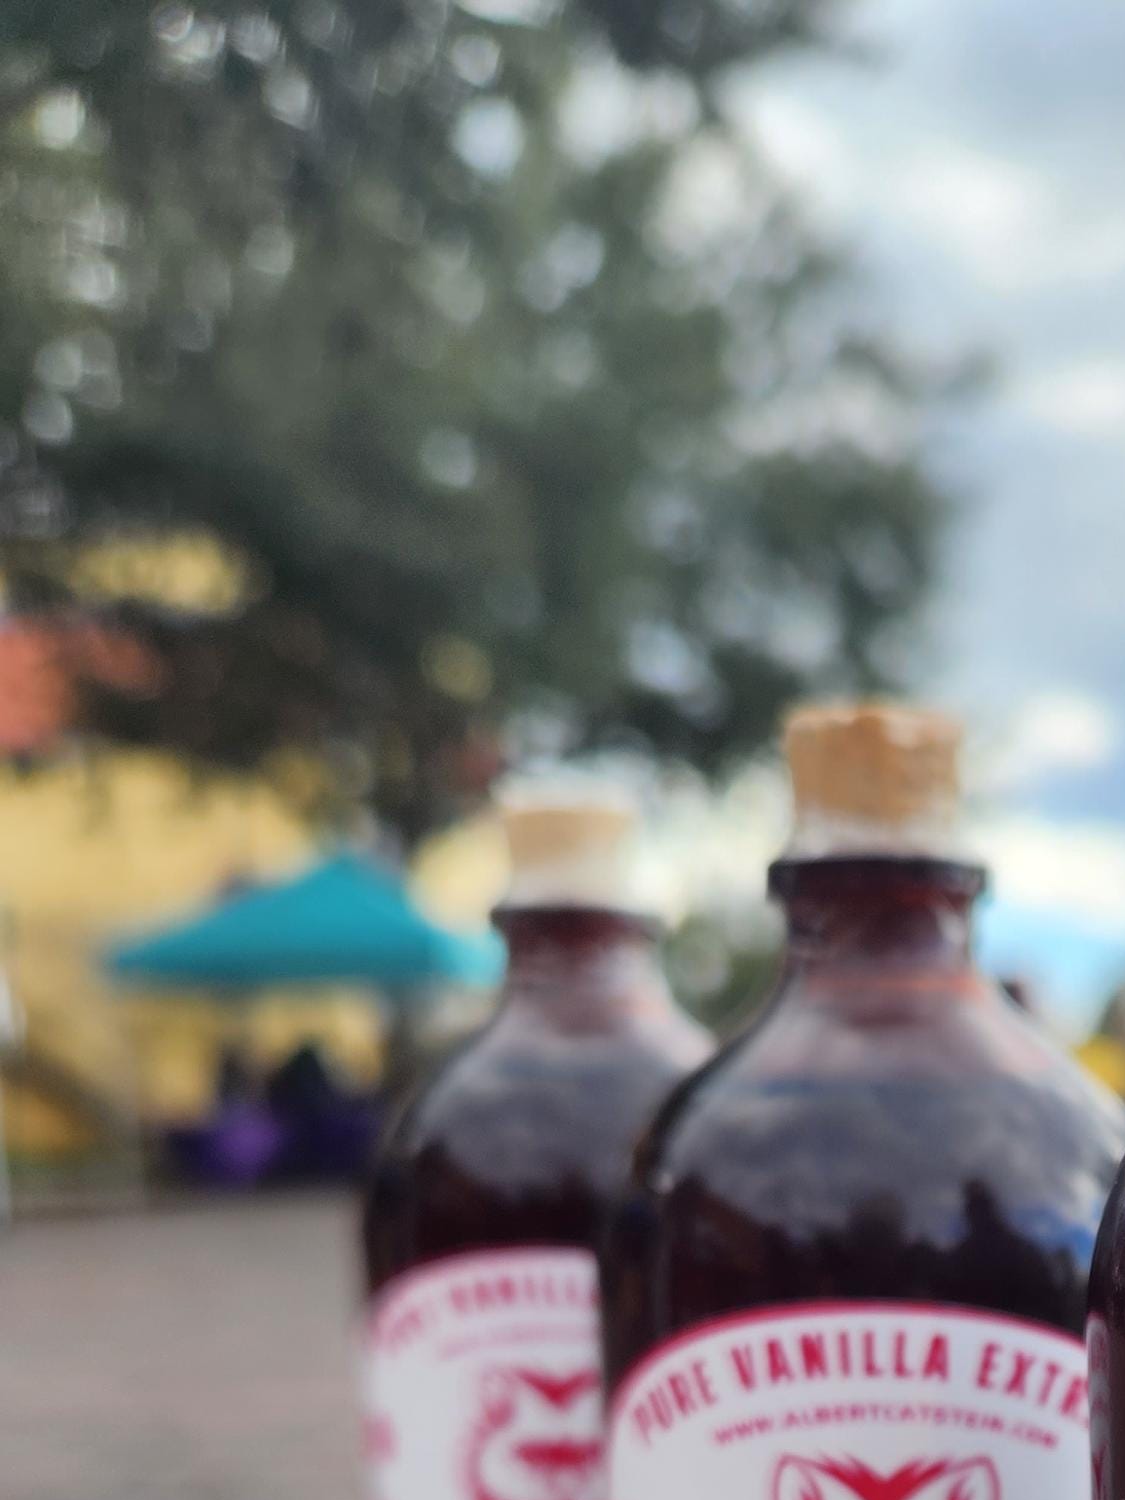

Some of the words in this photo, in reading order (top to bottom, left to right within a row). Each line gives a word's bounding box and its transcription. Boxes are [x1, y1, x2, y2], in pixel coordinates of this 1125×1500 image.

[631, 1360, 719, 1447] PURE
[729, 1330, 950, 1391] VANILLA
[976, 1342, 1089, 1429] EXTR
